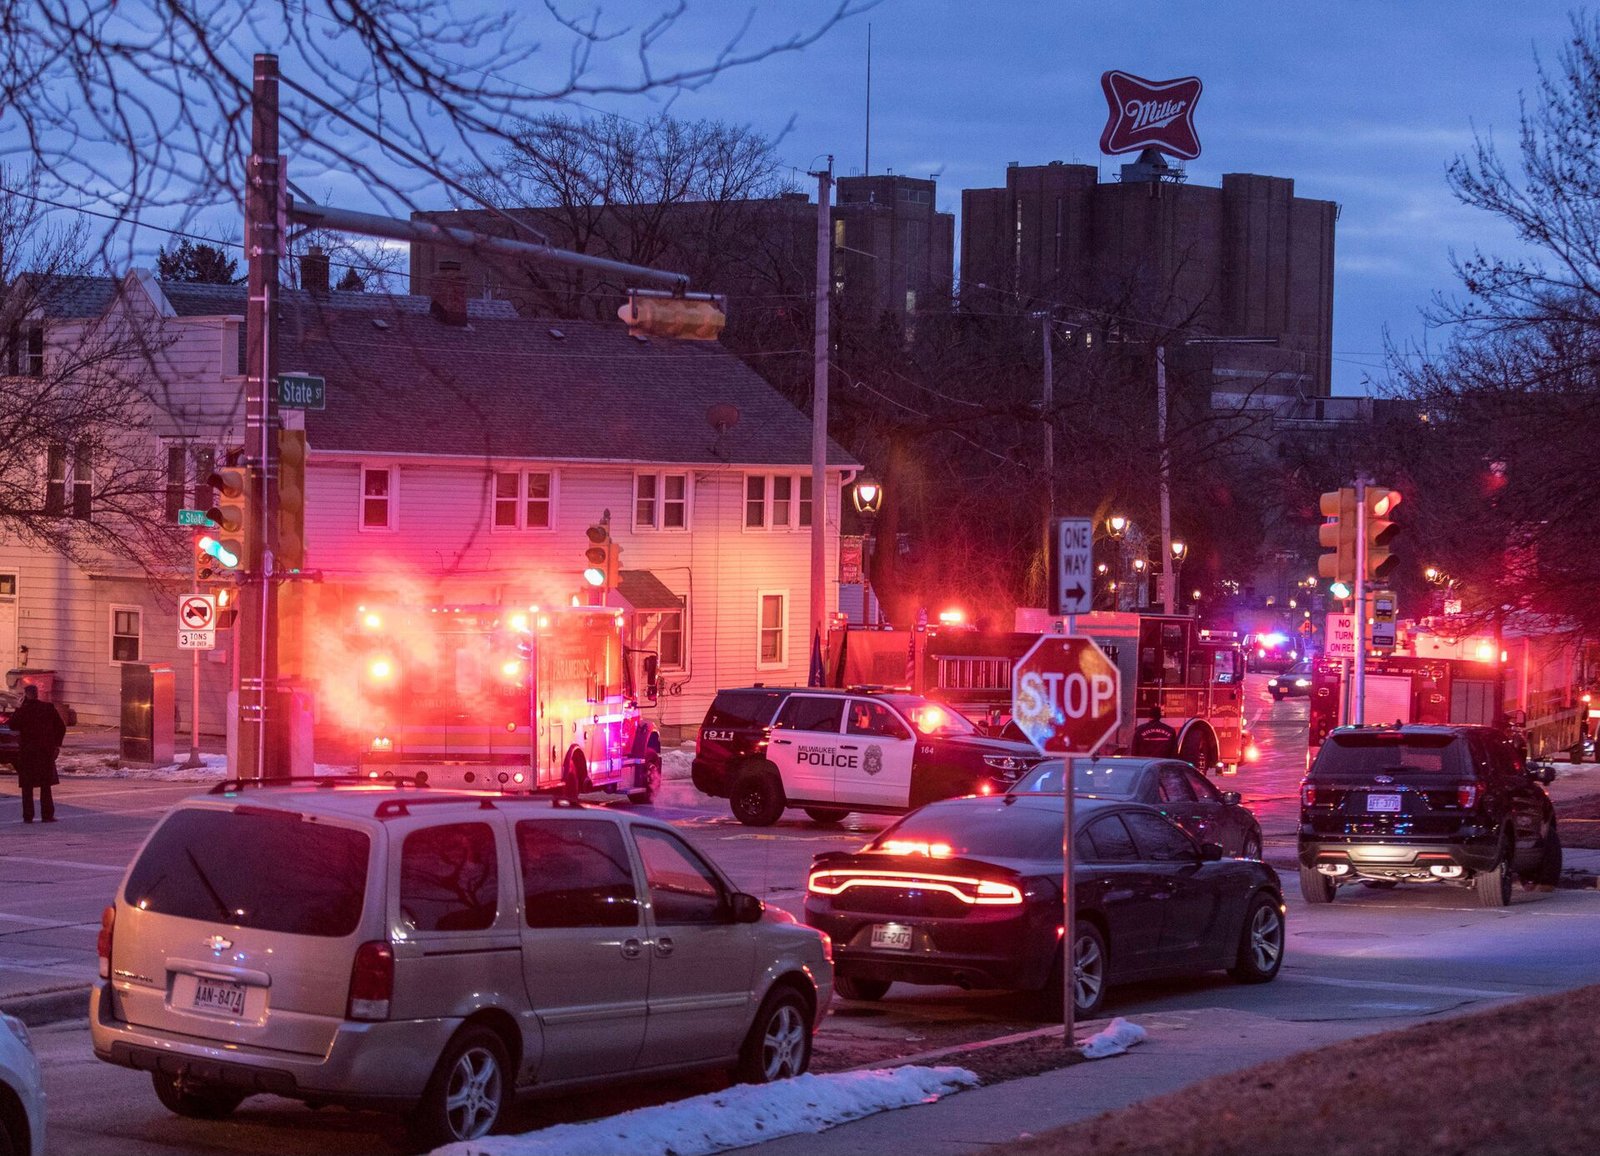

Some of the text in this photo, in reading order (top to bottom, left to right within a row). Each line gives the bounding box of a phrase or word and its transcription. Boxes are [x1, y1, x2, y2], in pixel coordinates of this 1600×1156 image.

[1125, 99, 1187, 130] Miller
[283, 380, 312, 403] State
[1064, 527, 1087, 549] ONE
[1064, 554, 1088, 576] WAY
[1338, 619, 1351, 628] NO
[181, 633, 207, 645] 3 TONS
[1335, 631, 1354, 640] TURN
[1330, 644, 1340, 652] ON
[1020, 671, 1115, 719] STOP
[708, 730, 734, 739] 911
[798, 745, 837, 754] MILWAUKEE
[921, 746, 934, 754] 164
[797, 752, 858, 769] POLICE
[194, 986, 242, 1008] AAN-8474
